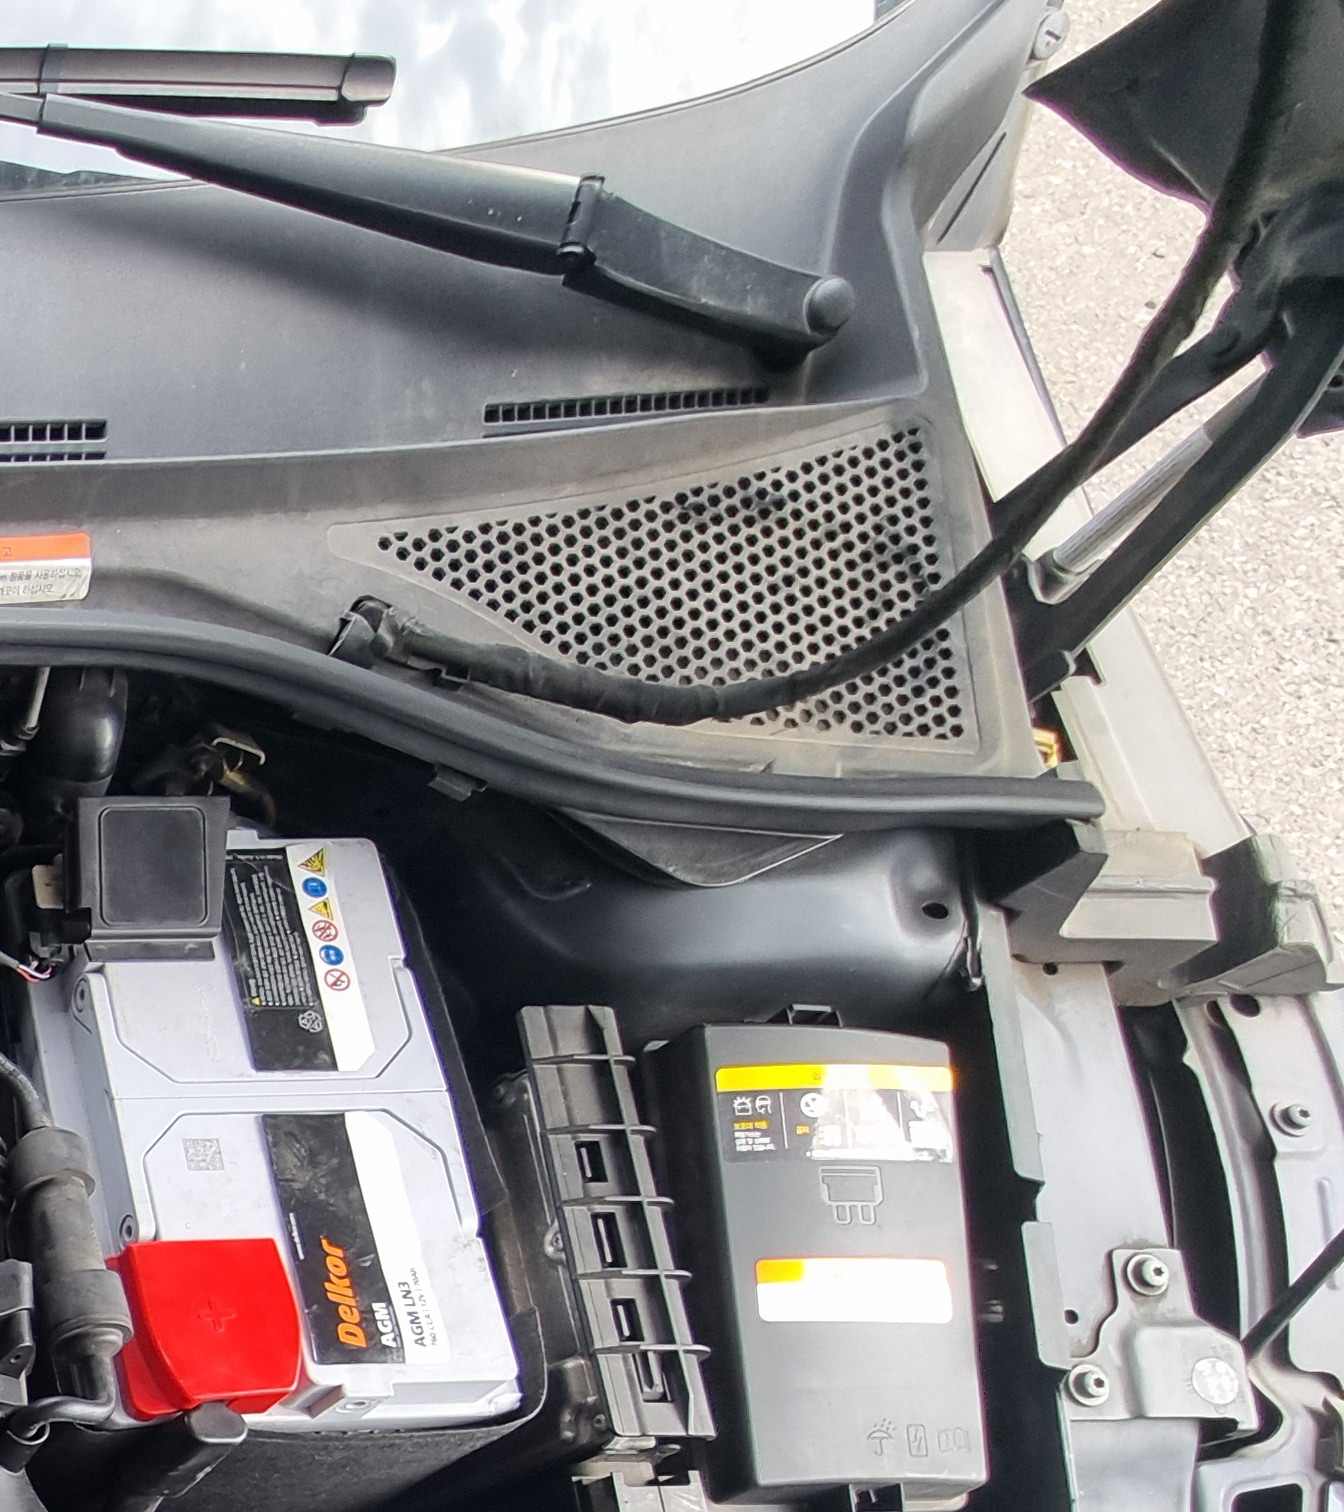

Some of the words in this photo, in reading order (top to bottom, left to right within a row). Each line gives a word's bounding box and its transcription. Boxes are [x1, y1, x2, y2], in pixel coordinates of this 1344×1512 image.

[321, 1237, 368, 1348] Delkor
[398, 1281, 416, 1307] LN3
[372, 1302, 397, 1348] AGM
[406, 1311, 427, 1348] AGM
